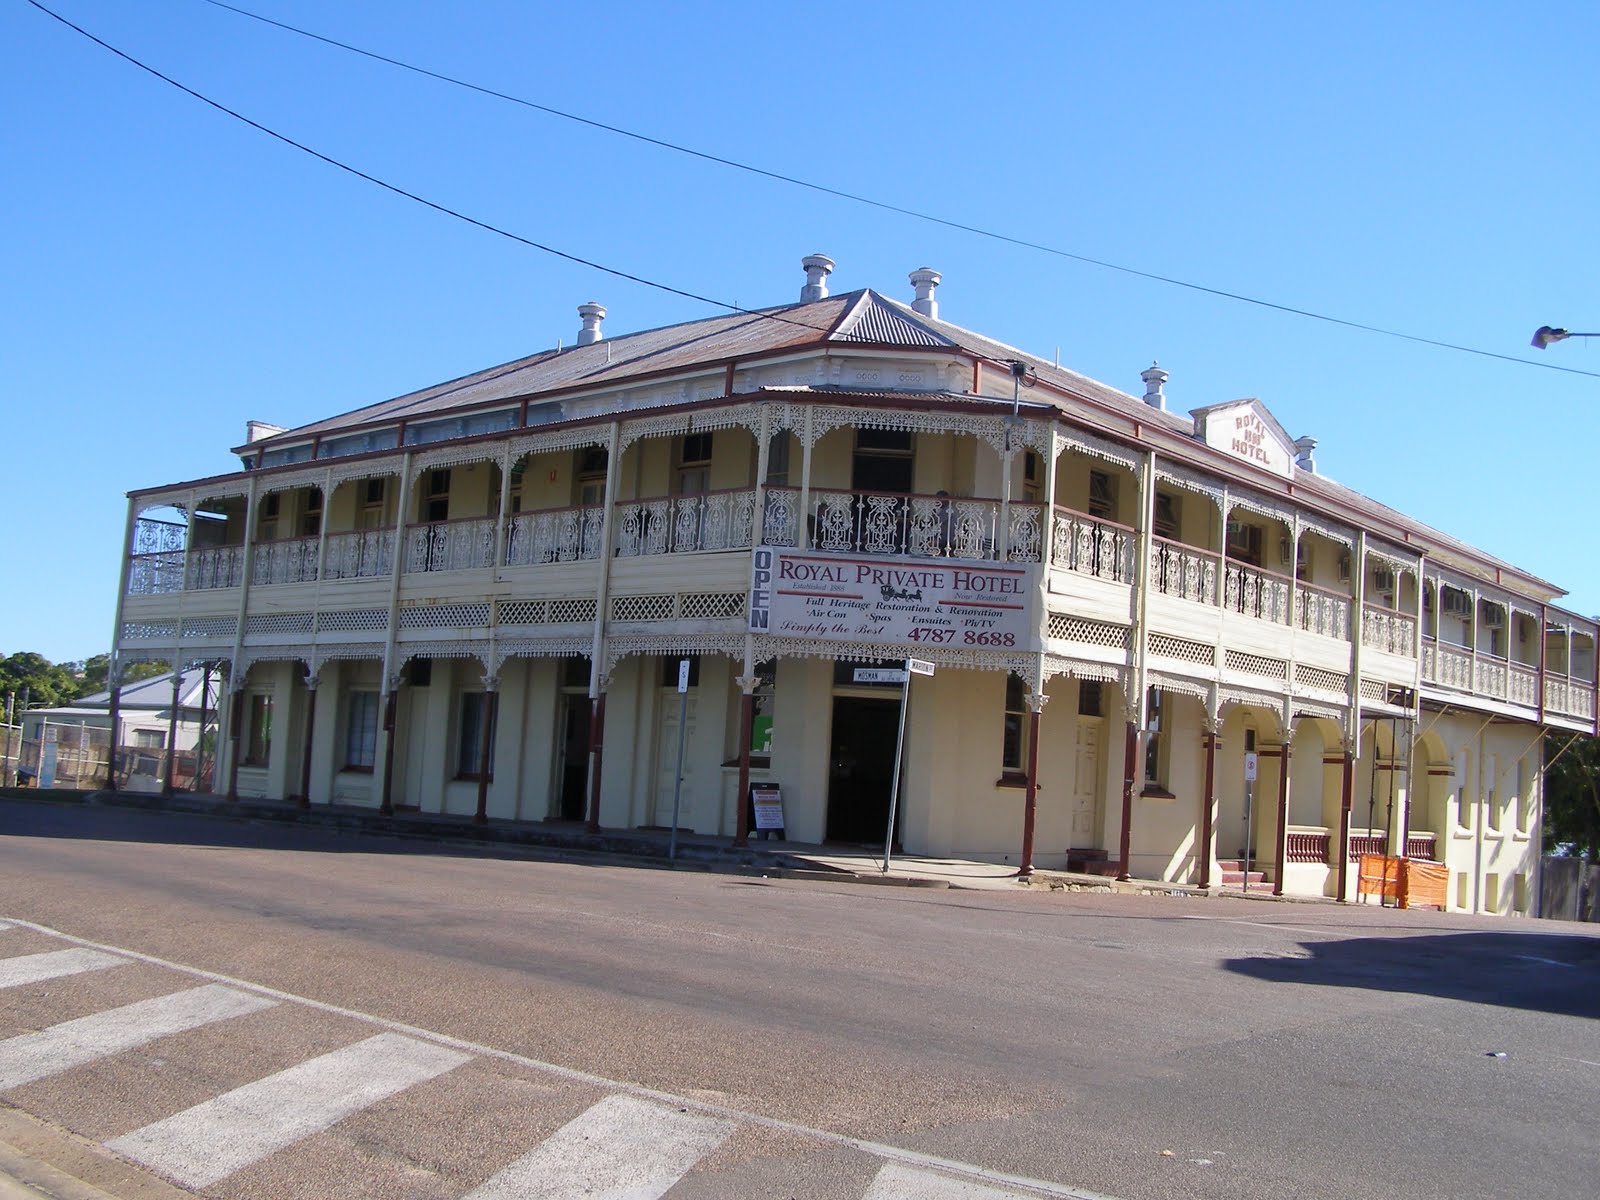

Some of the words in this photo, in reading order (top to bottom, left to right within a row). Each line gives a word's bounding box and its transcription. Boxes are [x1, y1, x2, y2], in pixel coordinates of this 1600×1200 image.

[1236, 412, 1265, 438] ROYAL
[1232, 438, 1270, 464] HOTEL
[779, 560, 849, 583] ROYAL
[855, 565, 945, 590] PRIVATE
[952, 572, 1025, 595] HOTEL
[751, 551, 772, 629] OPEN
[954, 592, 972, 600] Now
[976, 594, 1008, 602] Restored
[806, 597, 826, 606] Full
[829, 598, 871, 611] Heritage
[875, 602, 930, 614] Restoration
[934, 605, 943, 614] &
[949, 606, 1003, 618] Renovation
[827, 610, 847, 619] Con
[868, 613, 892, 623] Spas
[911, 615, 952, 626] Ensuites
[780, 619, 828, 635] Simply
[831, 623, 850, 634] the
[855, 624, 885, 635] Best
[907, 627, 956, 644] 4787
[963, 630, 1016, 648] 8688
[857, 671, 878, 681] MOSMAN
